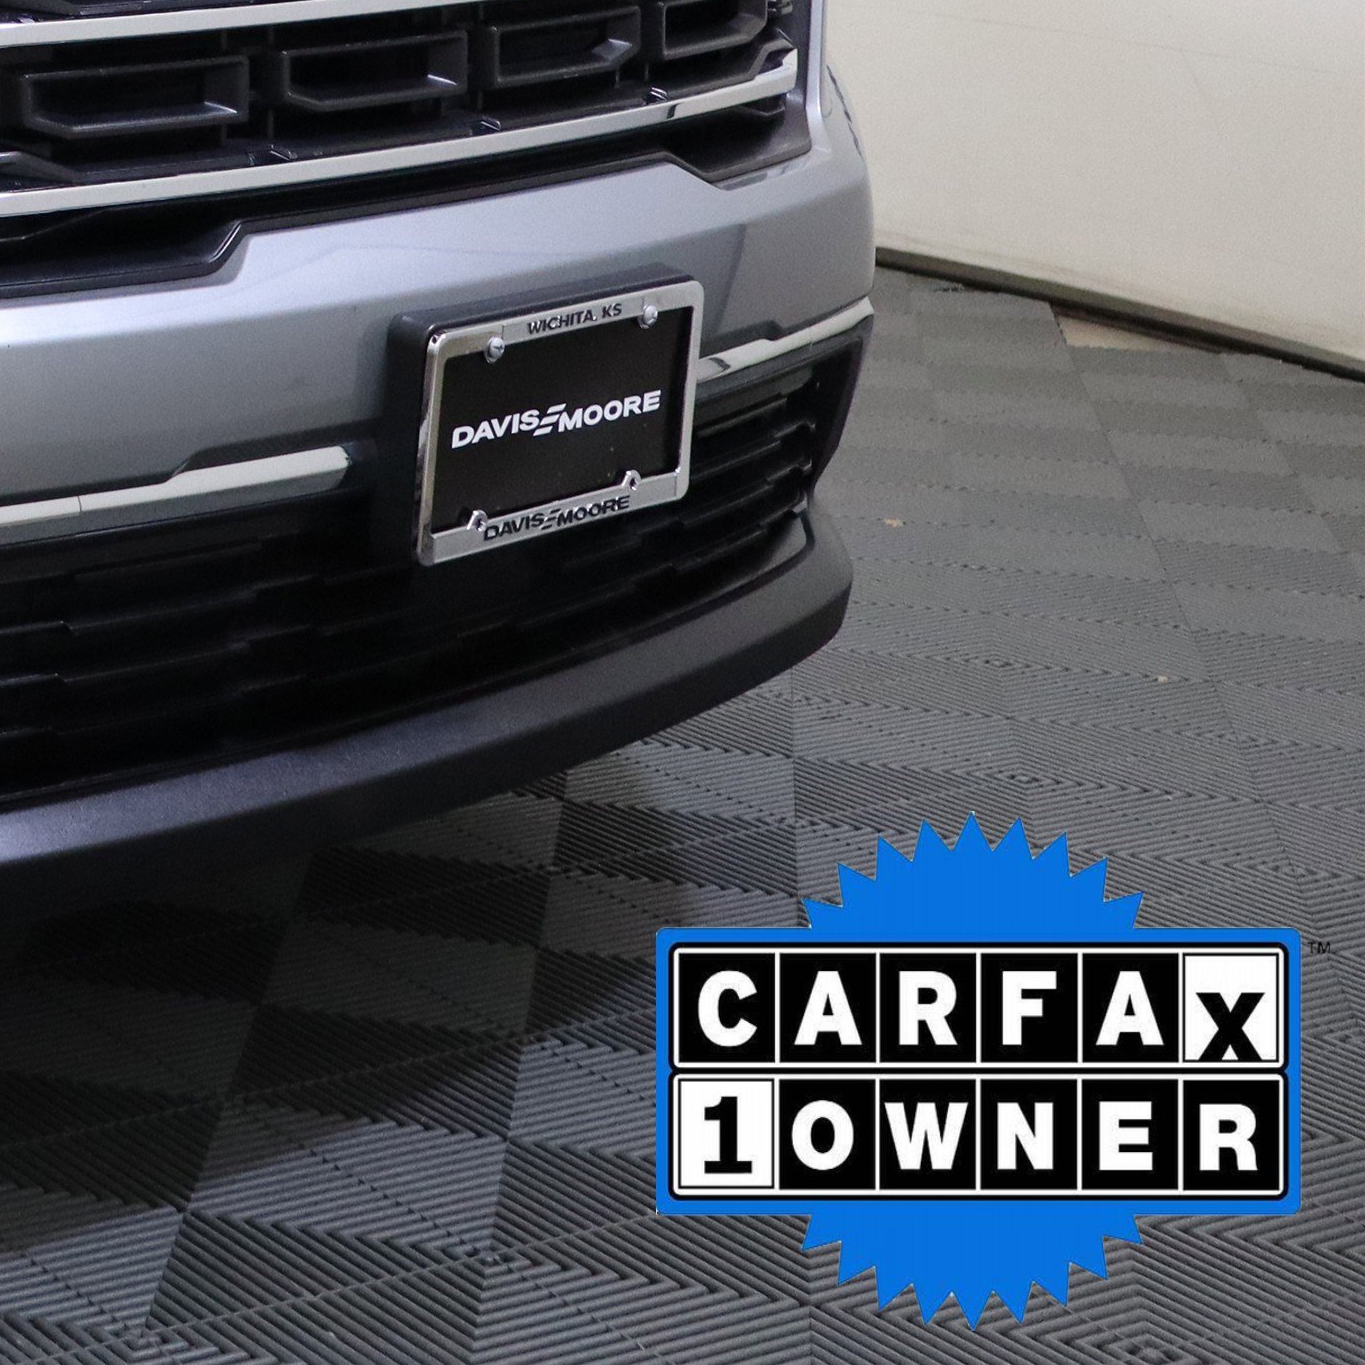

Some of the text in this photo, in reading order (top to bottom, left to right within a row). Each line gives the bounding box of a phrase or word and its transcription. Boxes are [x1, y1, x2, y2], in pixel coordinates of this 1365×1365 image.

[601, 303, 623, 319] KS
[451, 390, 662, 449] DAVIS MOORE
[483, 495, 631, 542] DAVIS MOORE
